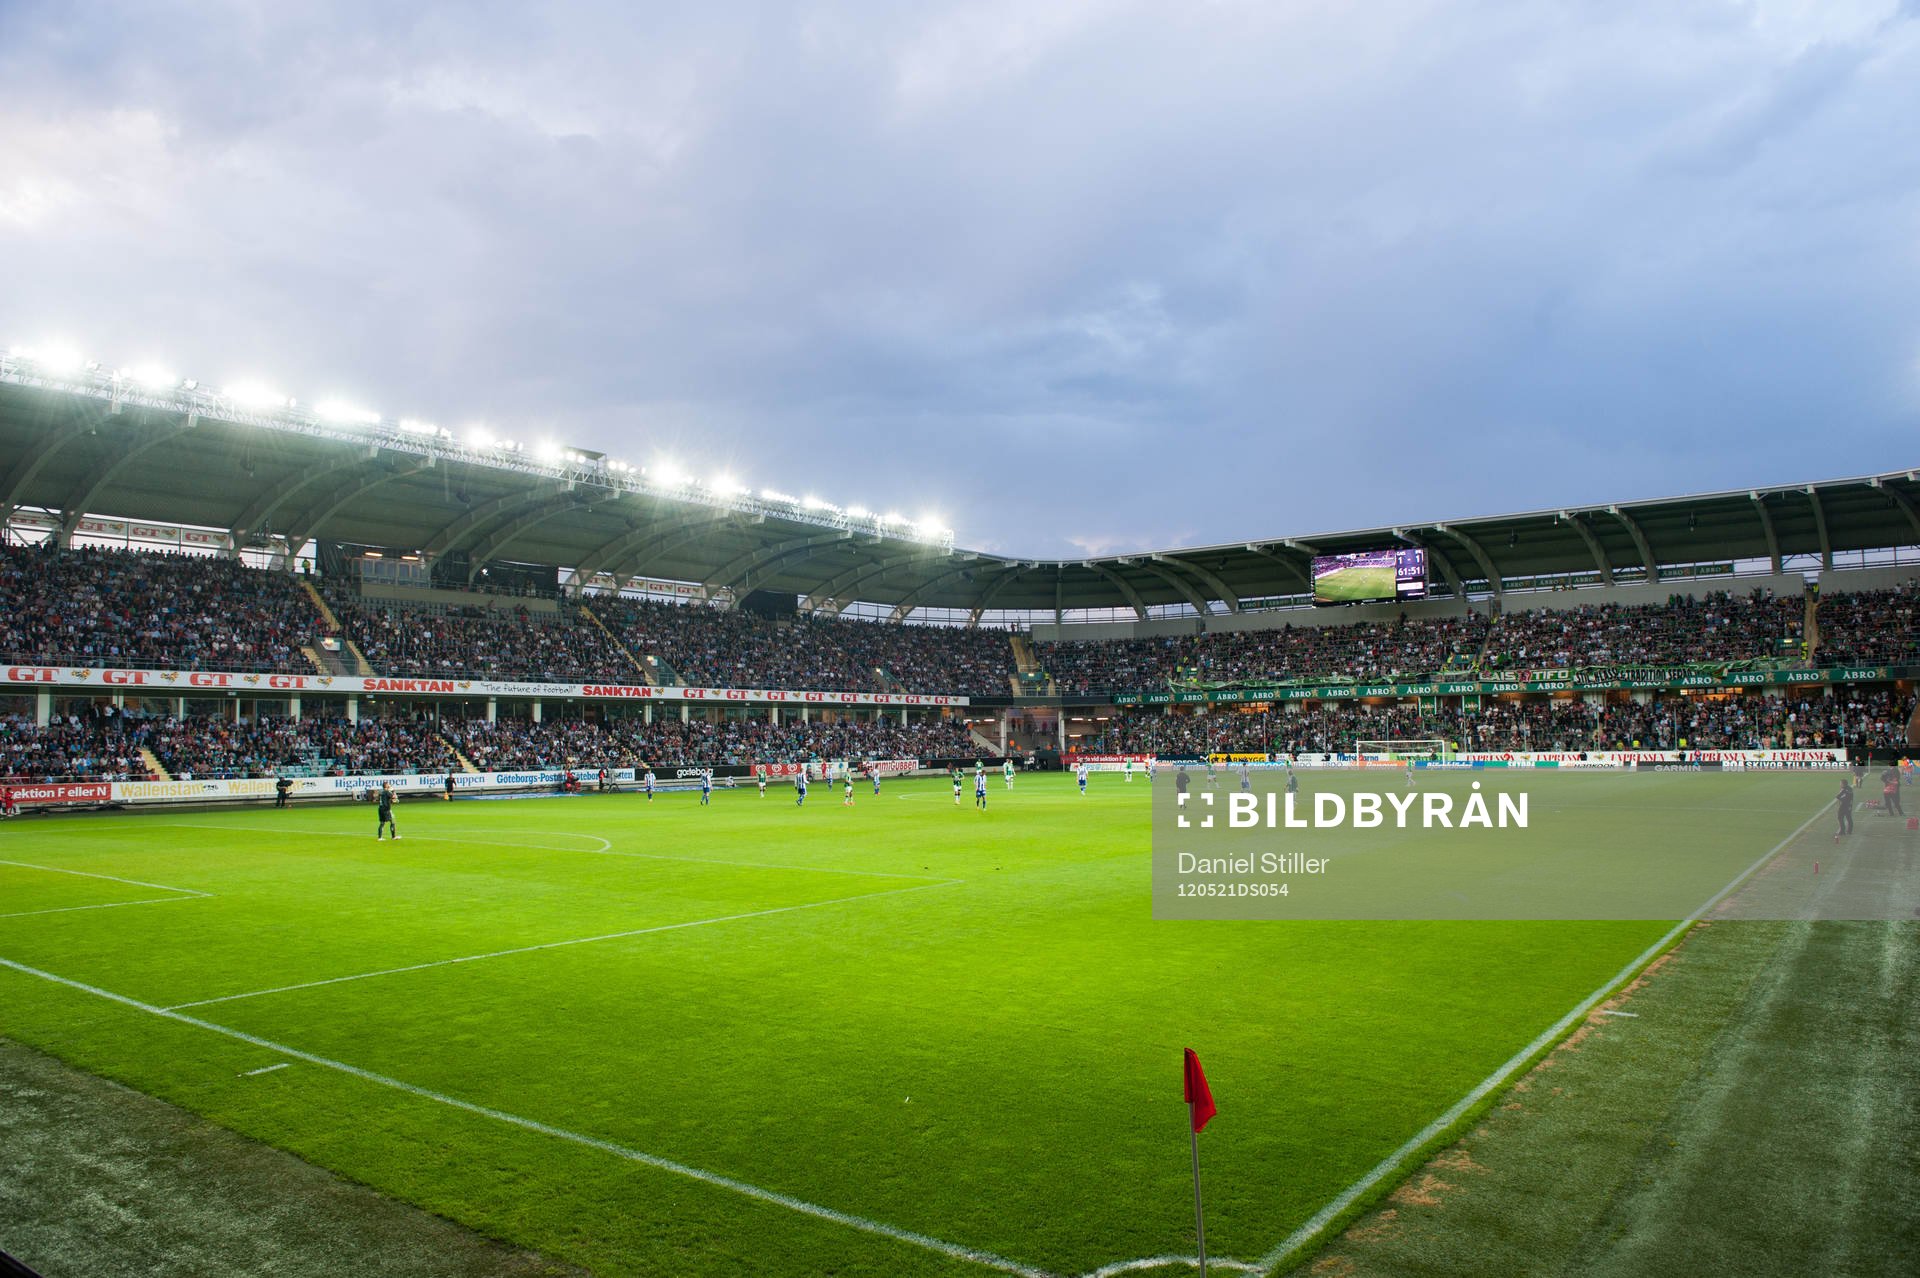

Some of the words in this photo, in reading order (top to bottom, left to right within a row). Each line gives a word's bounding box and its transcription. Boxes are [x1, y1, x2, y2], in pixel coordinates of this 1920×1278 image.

[8, 667, 59, 682] GT
[103, 670, 150, 684] GT
[1533, 670, 1569, 681] TIFO
[190, 673, 233, 687] GT
[269, 676, 309, 688] GT
[363, 679, 454, 692] SANKTAN
[504, 684, 530, 694] future
[533, 686, 542, 694] of
[582, 686, 652, 697] SANKTAN
[683, 689, 706, 698] GT
[727, 690, 748, 699] GT
[767, 691, 788, 700] GT
[805, 692, 825, 701] GT
[841, 693, 859, 702] GT
[874, 694, 892, 703] GT
[905, 695, 922, 704] GT
[935, 696, 950, 705] GT
[1611, 753, 1665, 761] EXPRESSEN
[1689, 752, 1746, 761] EPRESSEN
[1654, 764, 1701, 772] GARMIN
[1746, 761, 1783, 769] SKIVOR
[1785, 761, 1808, 769] TILL
[1811, 761, 1852, 769] BYGGET
[419, 774, 485, 789] Higabruppen
[13, 788, 55, 799] ektion
[57, 787, 66, 797] F
[68, 786, 94, 797] eller
[97, 785, 107, 797] N
